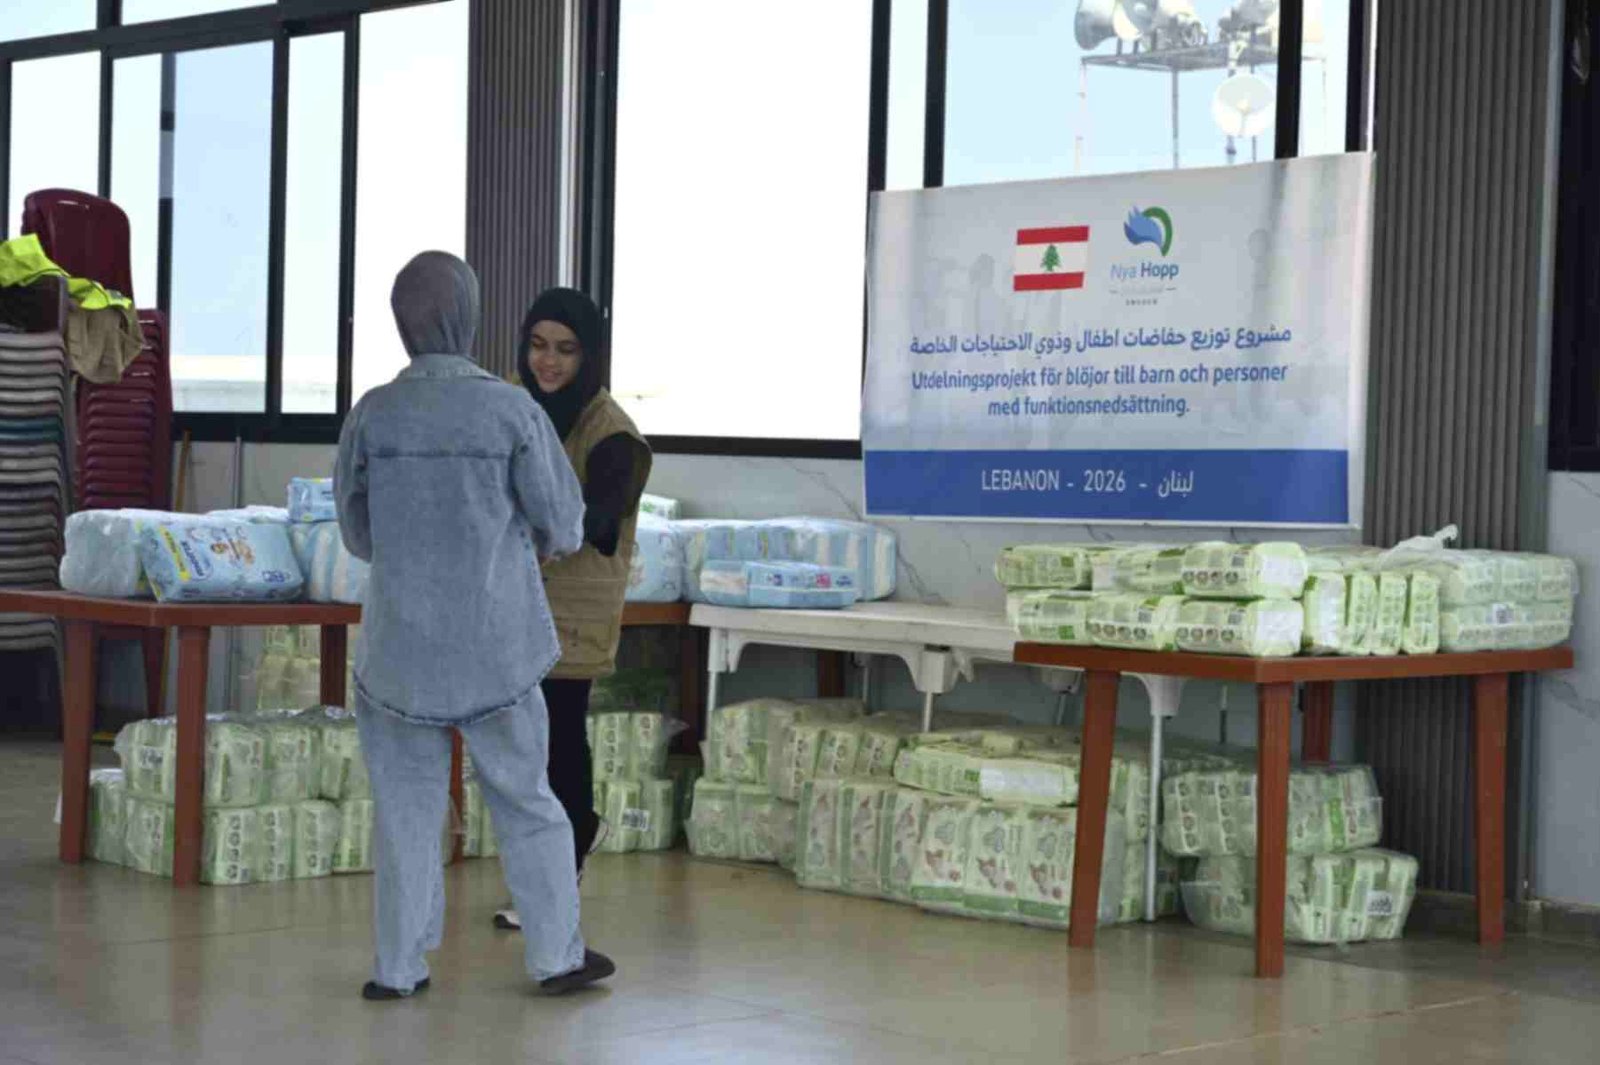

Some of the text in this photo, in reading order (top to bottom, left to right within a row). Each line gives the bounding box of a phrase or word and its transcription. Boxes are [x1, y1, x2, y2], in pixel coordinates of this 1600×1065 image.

[1110, 262, 1180, 282] Nya Hopp
[909, 324, 1292, 359] مشروع توزيع حفاضات اطفال وذوي الاحتياجات الخاصة
[911, 362, 1289, 392] Utdelningsprojekt för blöjor till barn och personer
[987, 393, 1191, 418] med funktionsnedsättning.
[980, 468, 1060, 491] LEBANON
[1083, 469, 1127, 492] 2026
[1157, 470, 1195, 498] لبنان
